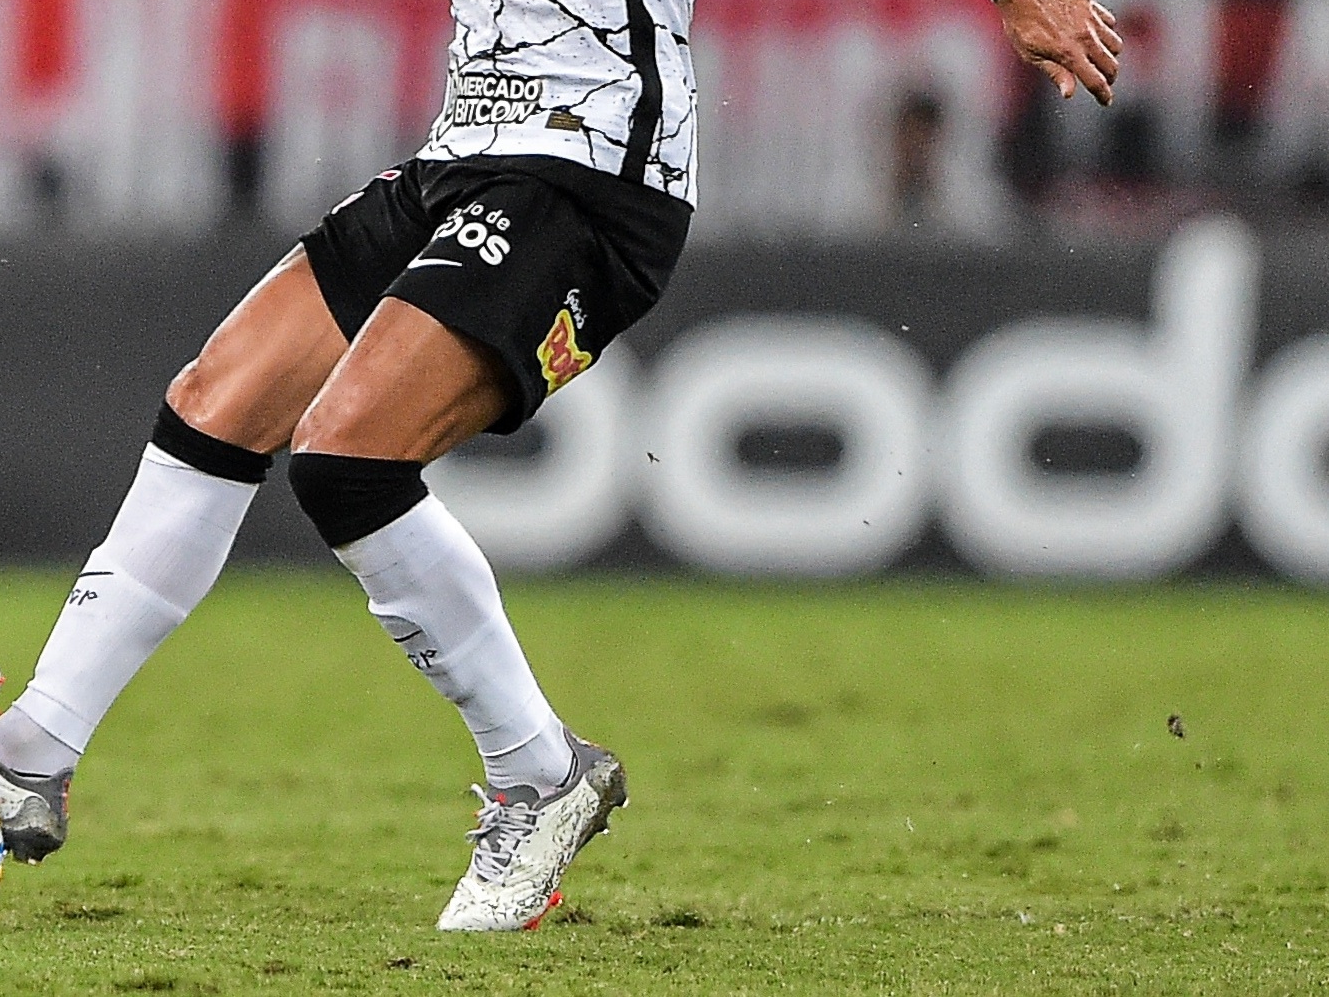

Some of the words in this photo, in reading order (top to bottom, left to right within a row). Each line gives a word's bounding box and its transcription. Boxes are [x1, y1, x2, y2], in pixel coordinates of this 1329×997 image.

[457, 76, 540, 102] MERCADO
[454, 97, 537, 124] BITCOIN
[485, 209, 512, 231] de
